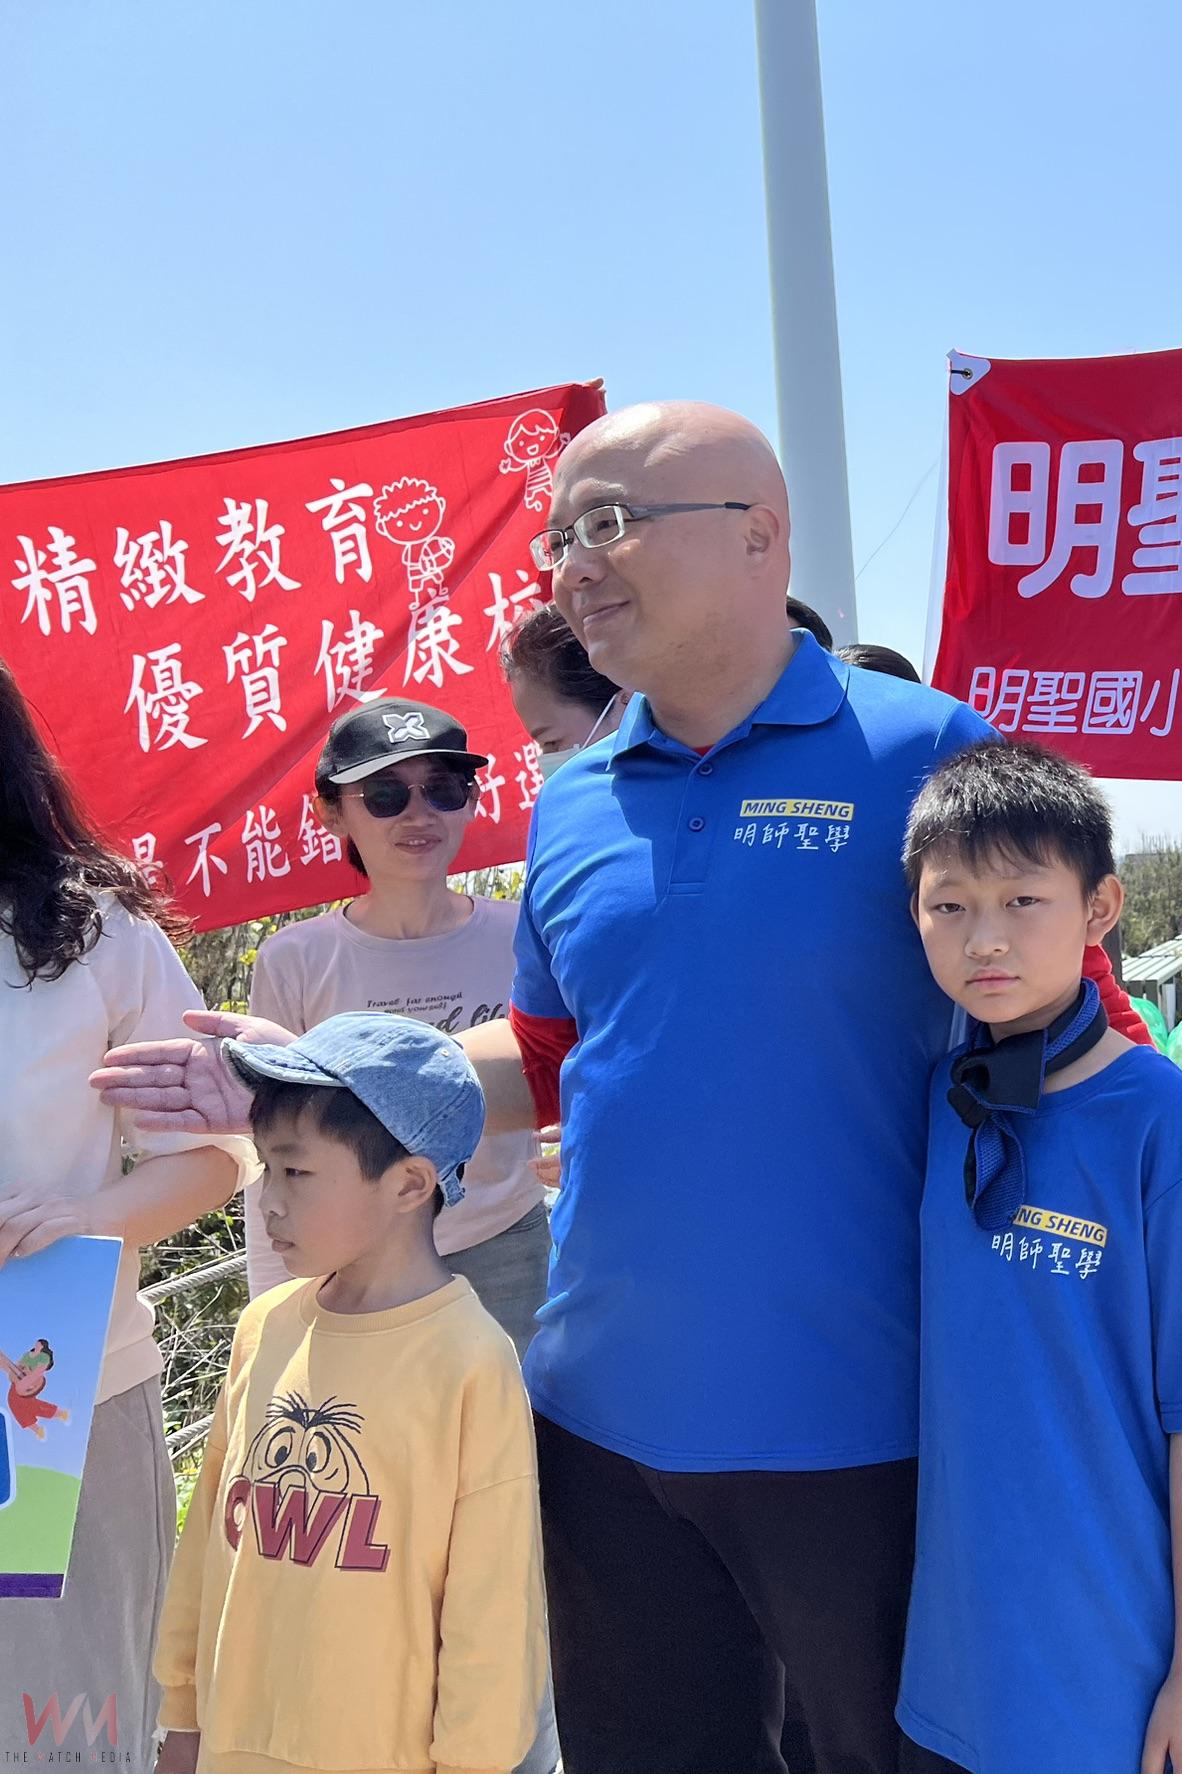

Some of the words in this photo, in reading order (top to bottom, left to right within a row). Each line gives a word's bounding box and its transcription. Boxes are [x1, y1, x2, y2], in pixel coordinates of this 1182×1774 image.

[10, 477, 375, 636] 精緻教育
[743, 801, 787, 815] MING
[790, 801, 850, 818] SHENG
[733, 821, 851, 853] 明師聖學
[1045, 1214, 1105, 1242] SHENG
[991, 1232, 1103, 1280] 明師聖學
